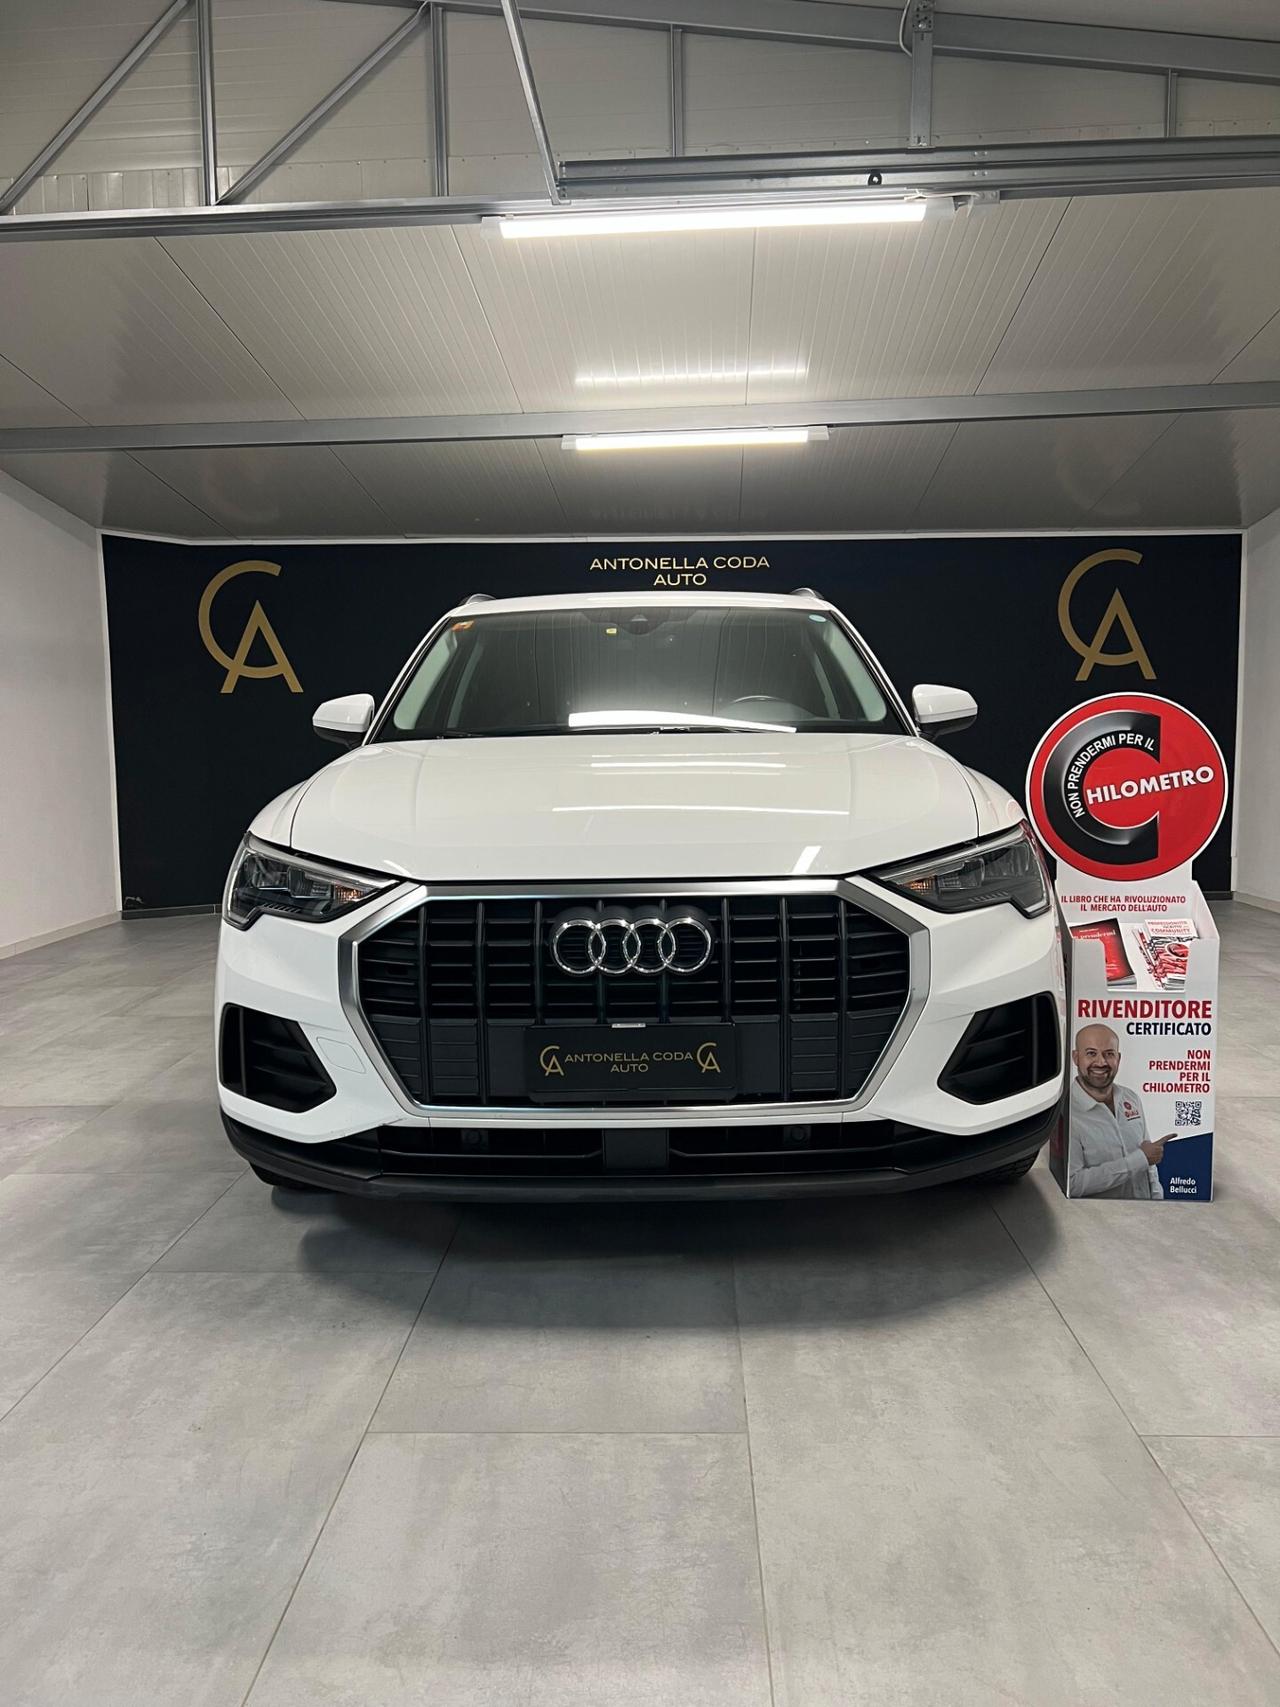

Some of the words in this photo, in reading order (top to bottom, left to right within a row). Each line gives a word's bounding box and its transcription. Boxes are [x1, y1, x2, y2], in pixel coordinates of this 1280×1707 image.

[589, 556, 709, 571] ANTONELLA
[713, 556, 770, 569] CODA
[653, 573, 707, 586] AUTO
[1118, 733, 1144, 746] PER
[1144, 737, 1155, 751] IL
[1067, 735, 1116, 790] PRENDERMI
[1067, 792, 1085, 818] NON
[1061, 896, 1068, 904] IL
[1069, 896, 1093, 904] LIBRO
[1093, 896, 1109, 904] CHE
[1110, 896, 1121, 904] HA
[1124, 895, 1187, 904] RIVOLUZIONATO
[1080, 904, 1088, 912] IL
[1090, 904, 1127, 912] MERCATO
[1128, 904, 1168, 912] DELL'AUTO
[1078, 999, 1212, 1019] RIVENDITORE
[1126, 1022, 1211, 1036] CERTIFICATO
[564, 1053, 650, 1063] ANTONELLA
[652, 1051, 694, 1061] CODA
[1187, 1050, 1211, 1059] NON
[610, 1063, 649, 1073] AUTO
[1149, 1061, 1211, 1070] PRENDERMI
[1179, 1072, 1199, 1081] PER
[1201, 1072, 1211, 1082] IL
[1142, 1082, 1210, 1093] CHILOMETRO
[1170, 1177, 1196, 1185] Alfredo
[1169, 1185, 1197, 1194] Bellucci
